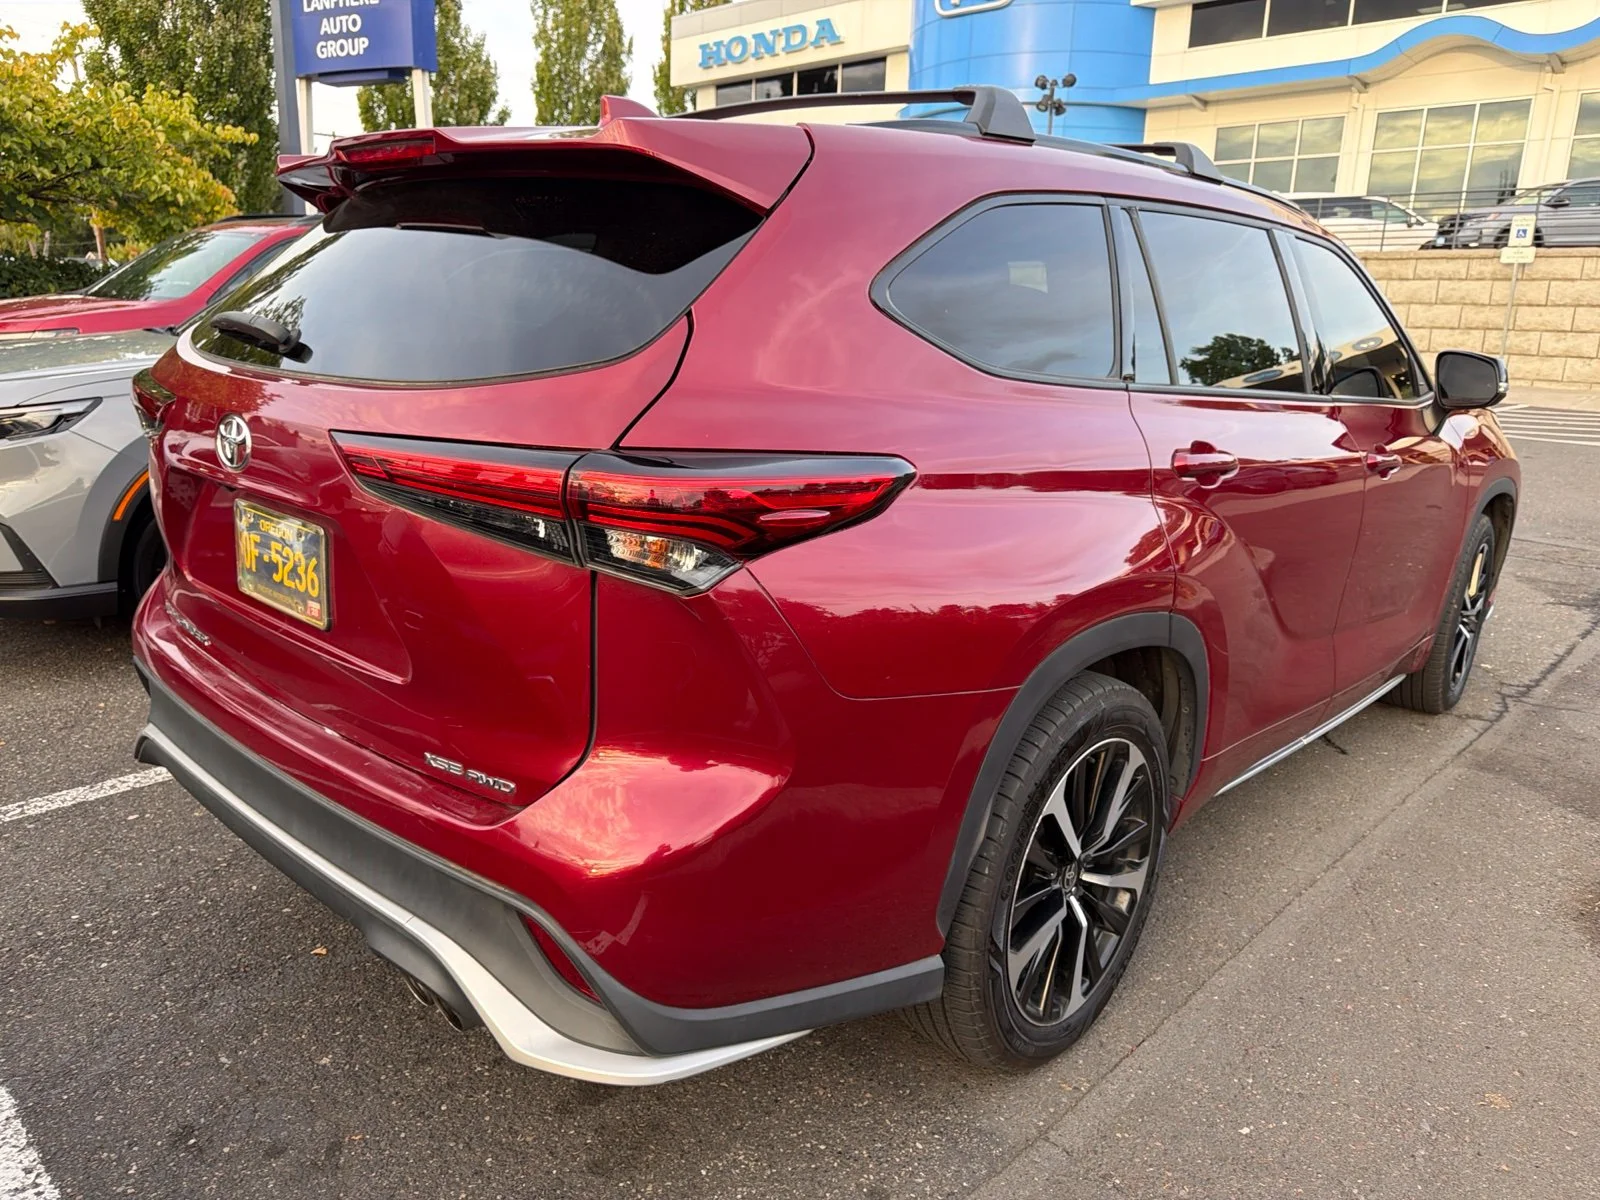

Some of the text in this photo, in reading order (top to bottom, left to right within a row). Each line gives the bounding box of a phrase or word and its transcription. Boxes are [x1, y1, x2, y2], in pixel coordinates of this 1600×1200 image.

[320, 14, 362, 35] AUTO
[316, 37, 369, 59] GROUP
[699, 18, 842, 69] HONDA
[424, 752, 463, 776] XSE
